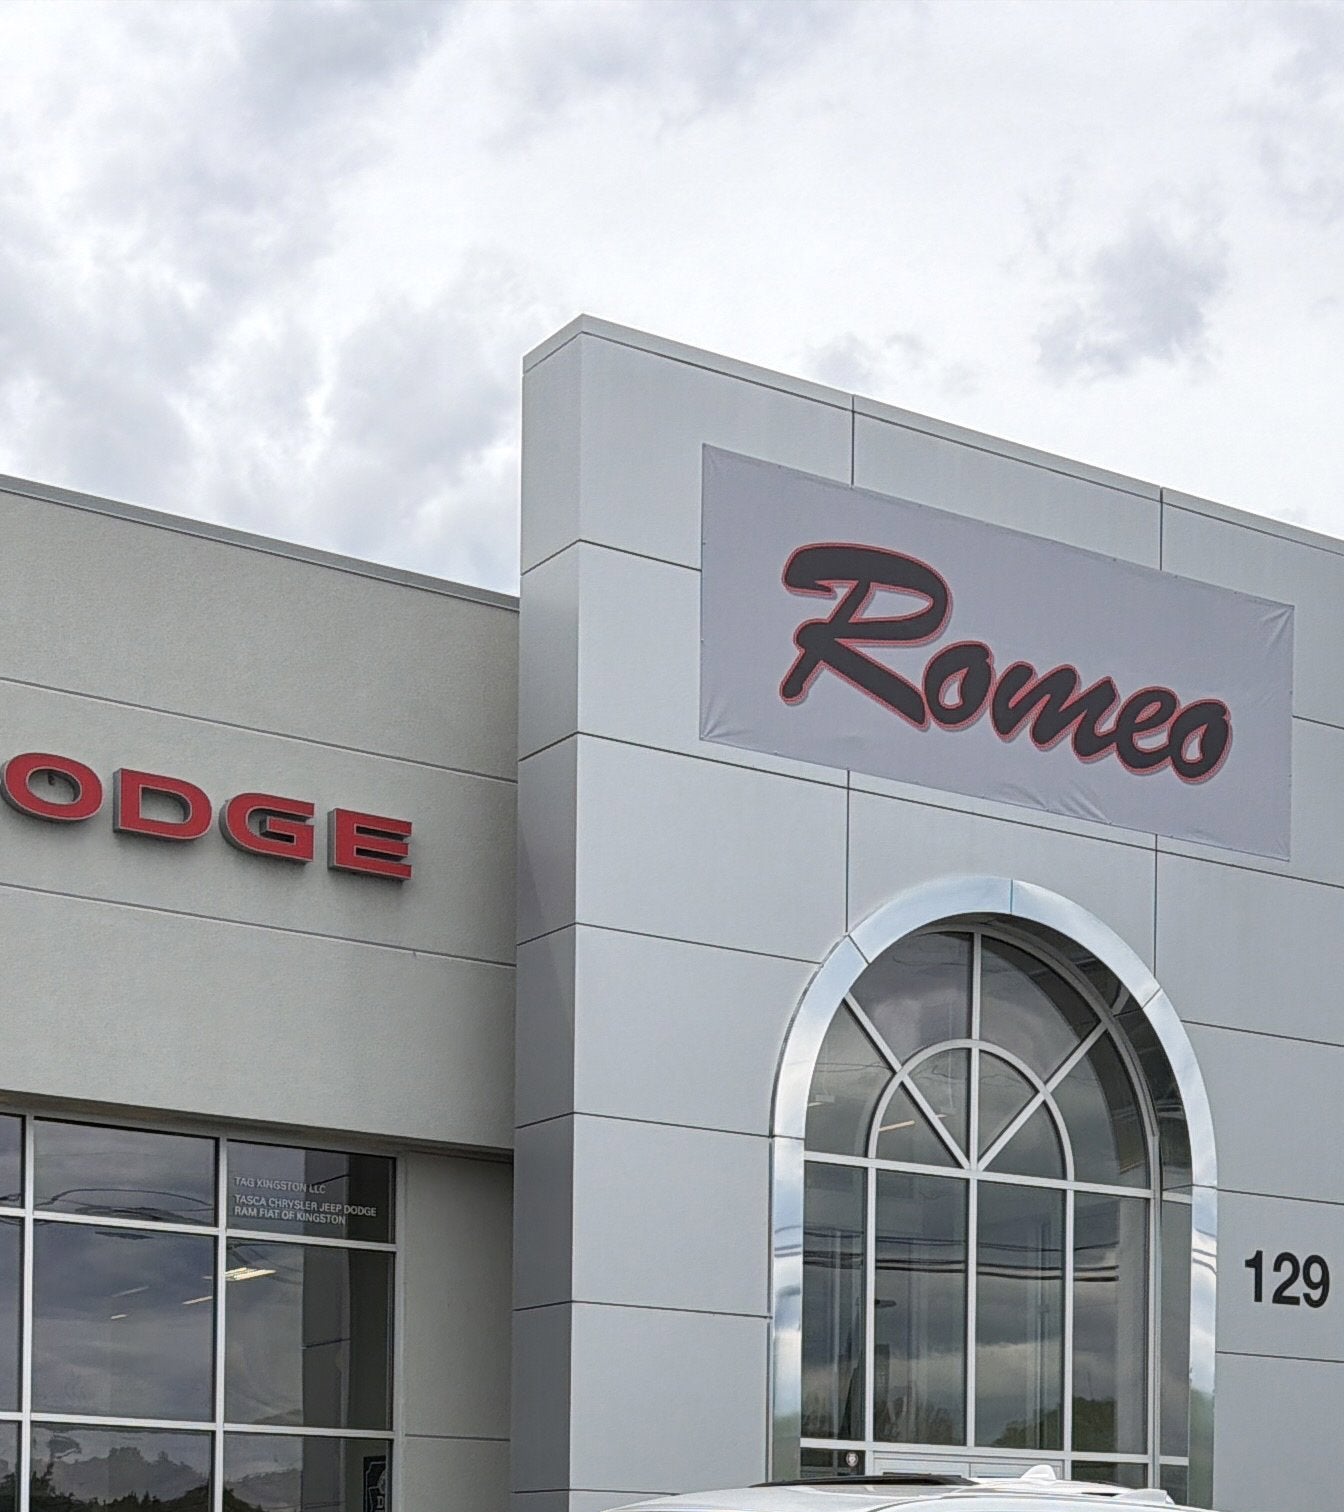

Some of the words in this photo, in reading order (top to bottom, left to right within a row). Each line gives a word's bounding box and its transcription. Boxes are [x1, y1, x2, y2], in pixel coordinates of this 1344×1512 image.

[780, 541, 1233, 783] Romeo
[234, 1177, 255, 1188] TAG
[257, 1179, 307, 1193] KINGSTON
[309, 1184, 327, 1194] LLC
[234, 1194, 267, 1206] TASCA
[268, 1197, 318, 1212] CHRYSLER
[319, 1202, 343, 1213] JEEP
[343, 1204, 377, 1217] DODGE
[234, 1205, 257, 1217] RAM
[259, 1208, 280, 1218] FIAT
[281, 1210, 296, 1220] OF
[296, 1210, 346, 1225] KINGSTON
[1244, 1249, 1330, 1309] 129
